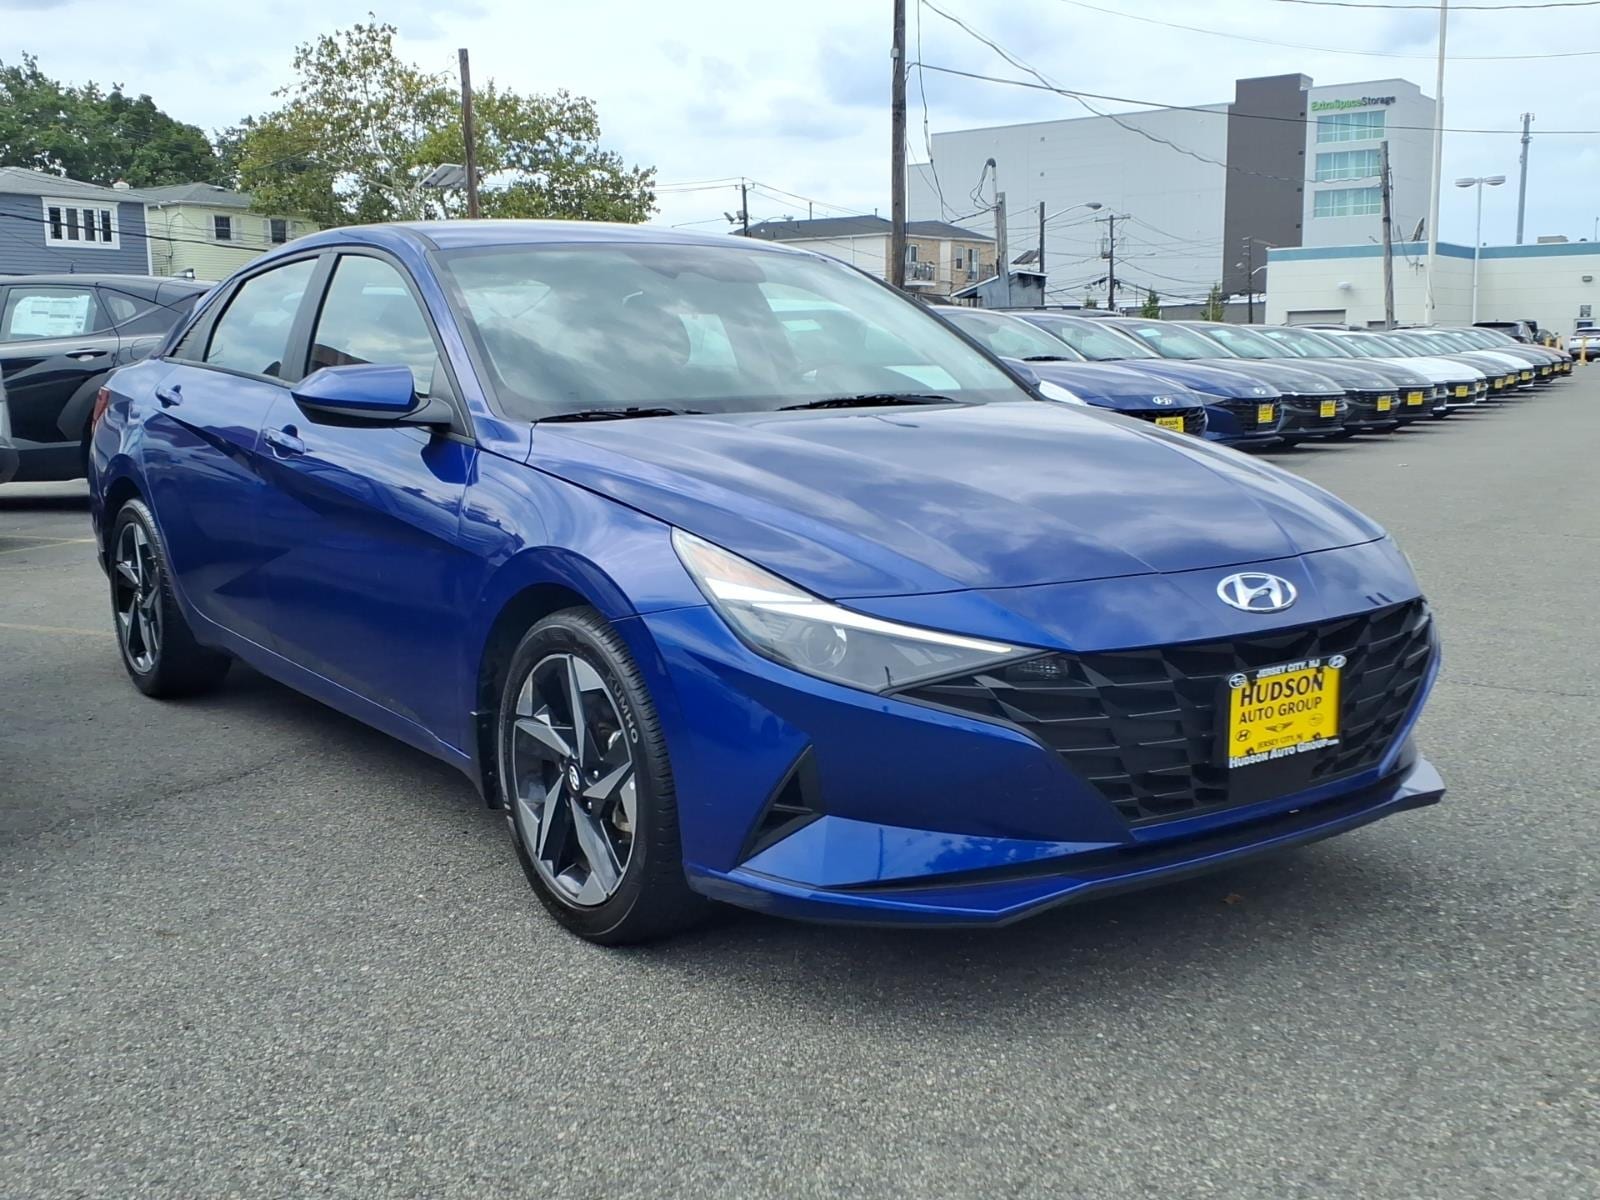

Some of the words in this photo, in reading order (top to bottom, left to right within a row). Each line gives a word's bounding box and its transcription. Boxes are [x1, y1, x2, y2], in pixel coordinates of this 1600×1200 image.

[1240, 674, 1324, 707] HUDSON
[1239, 706, 1274, 725] AUTO
[1278, 696, 1322, 716] GROUP
[1229, 752, 1268, 768] HUDSON
[1270, 746, 1296, 759] AUTO
